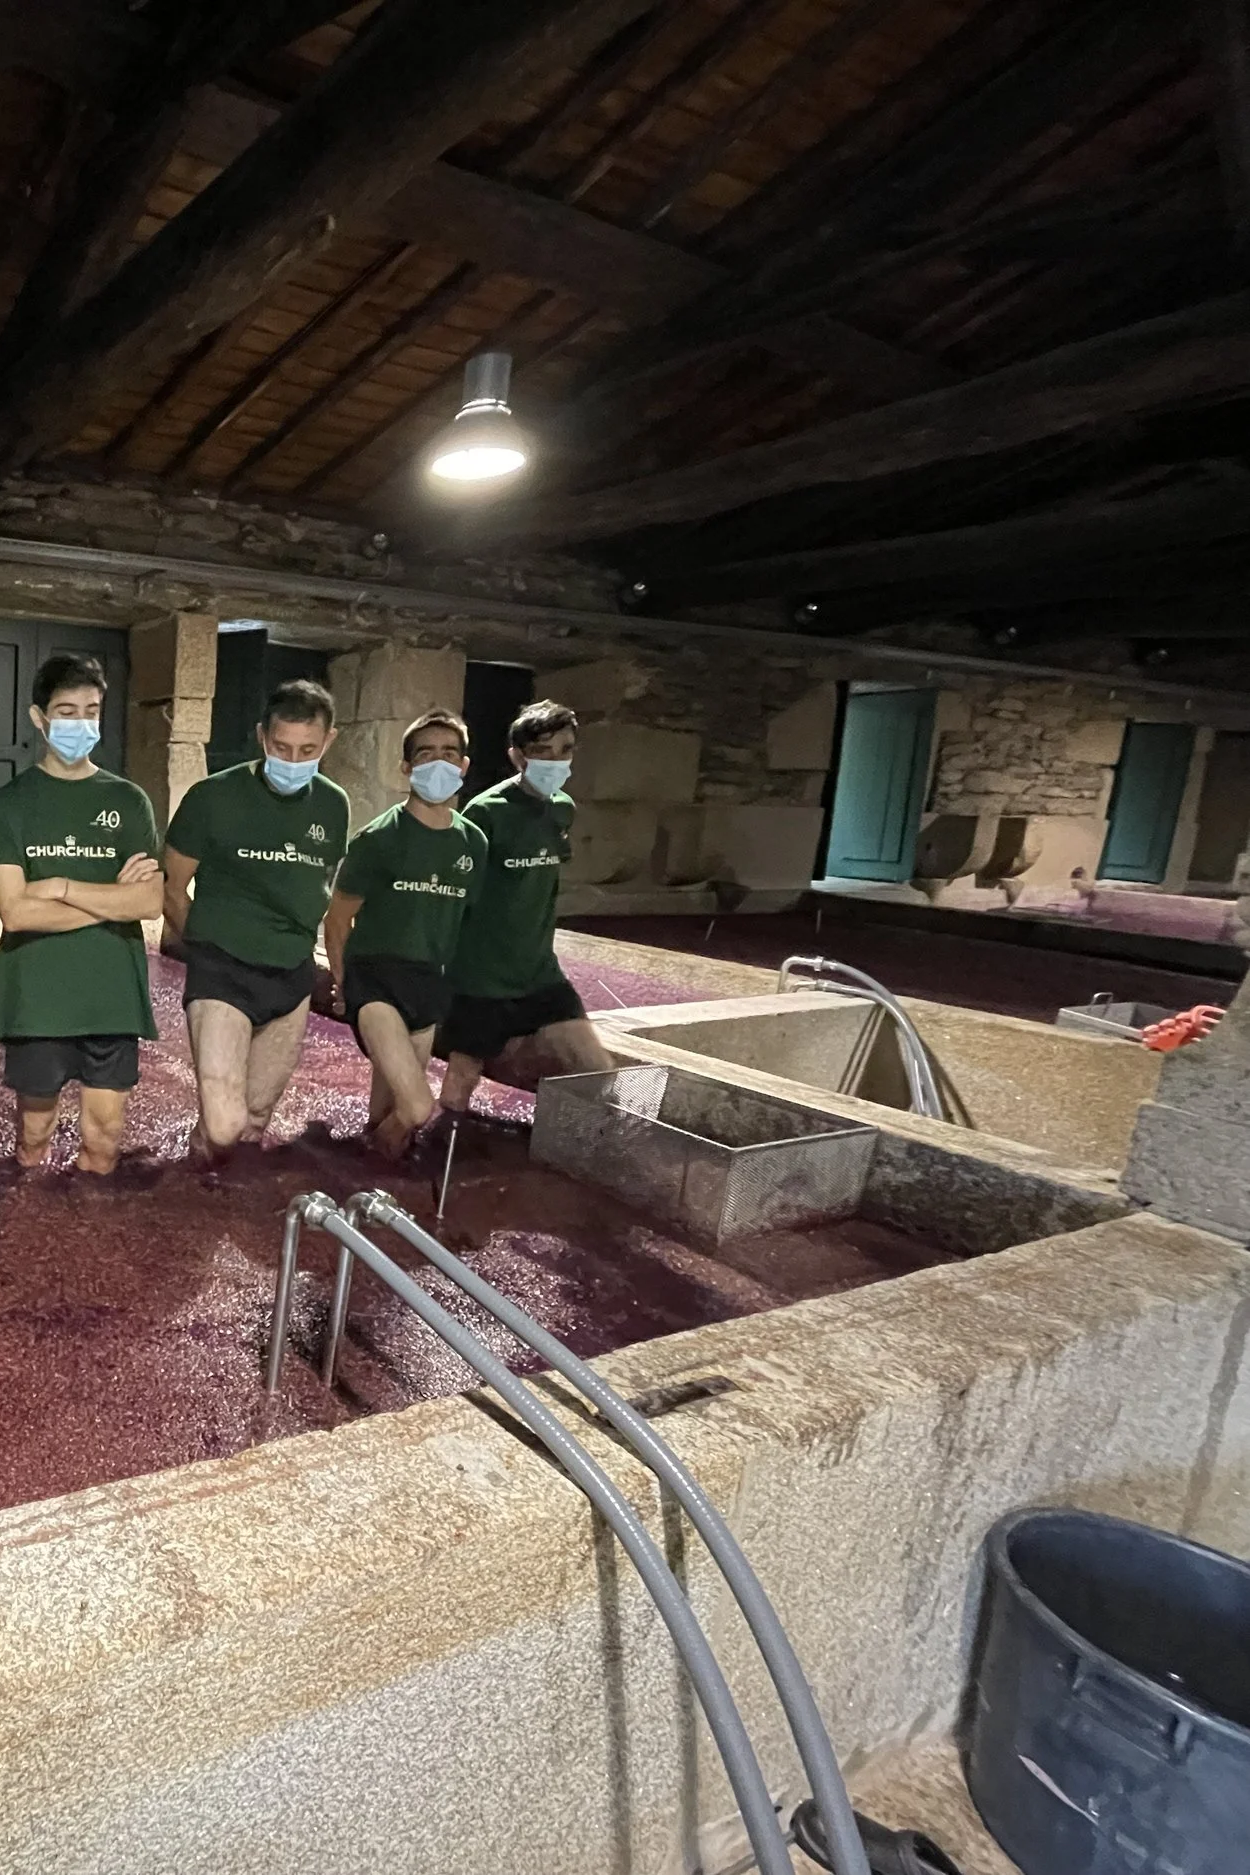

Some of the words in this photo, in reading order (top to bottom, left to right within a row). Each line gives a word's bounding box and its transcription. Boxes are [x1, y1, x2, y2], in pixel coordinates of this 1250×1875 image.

[96, 810, 120, 828] 40
[308, 823, 325, 841] 40
[25, 845, 116, 858] CHURCHILL'S
